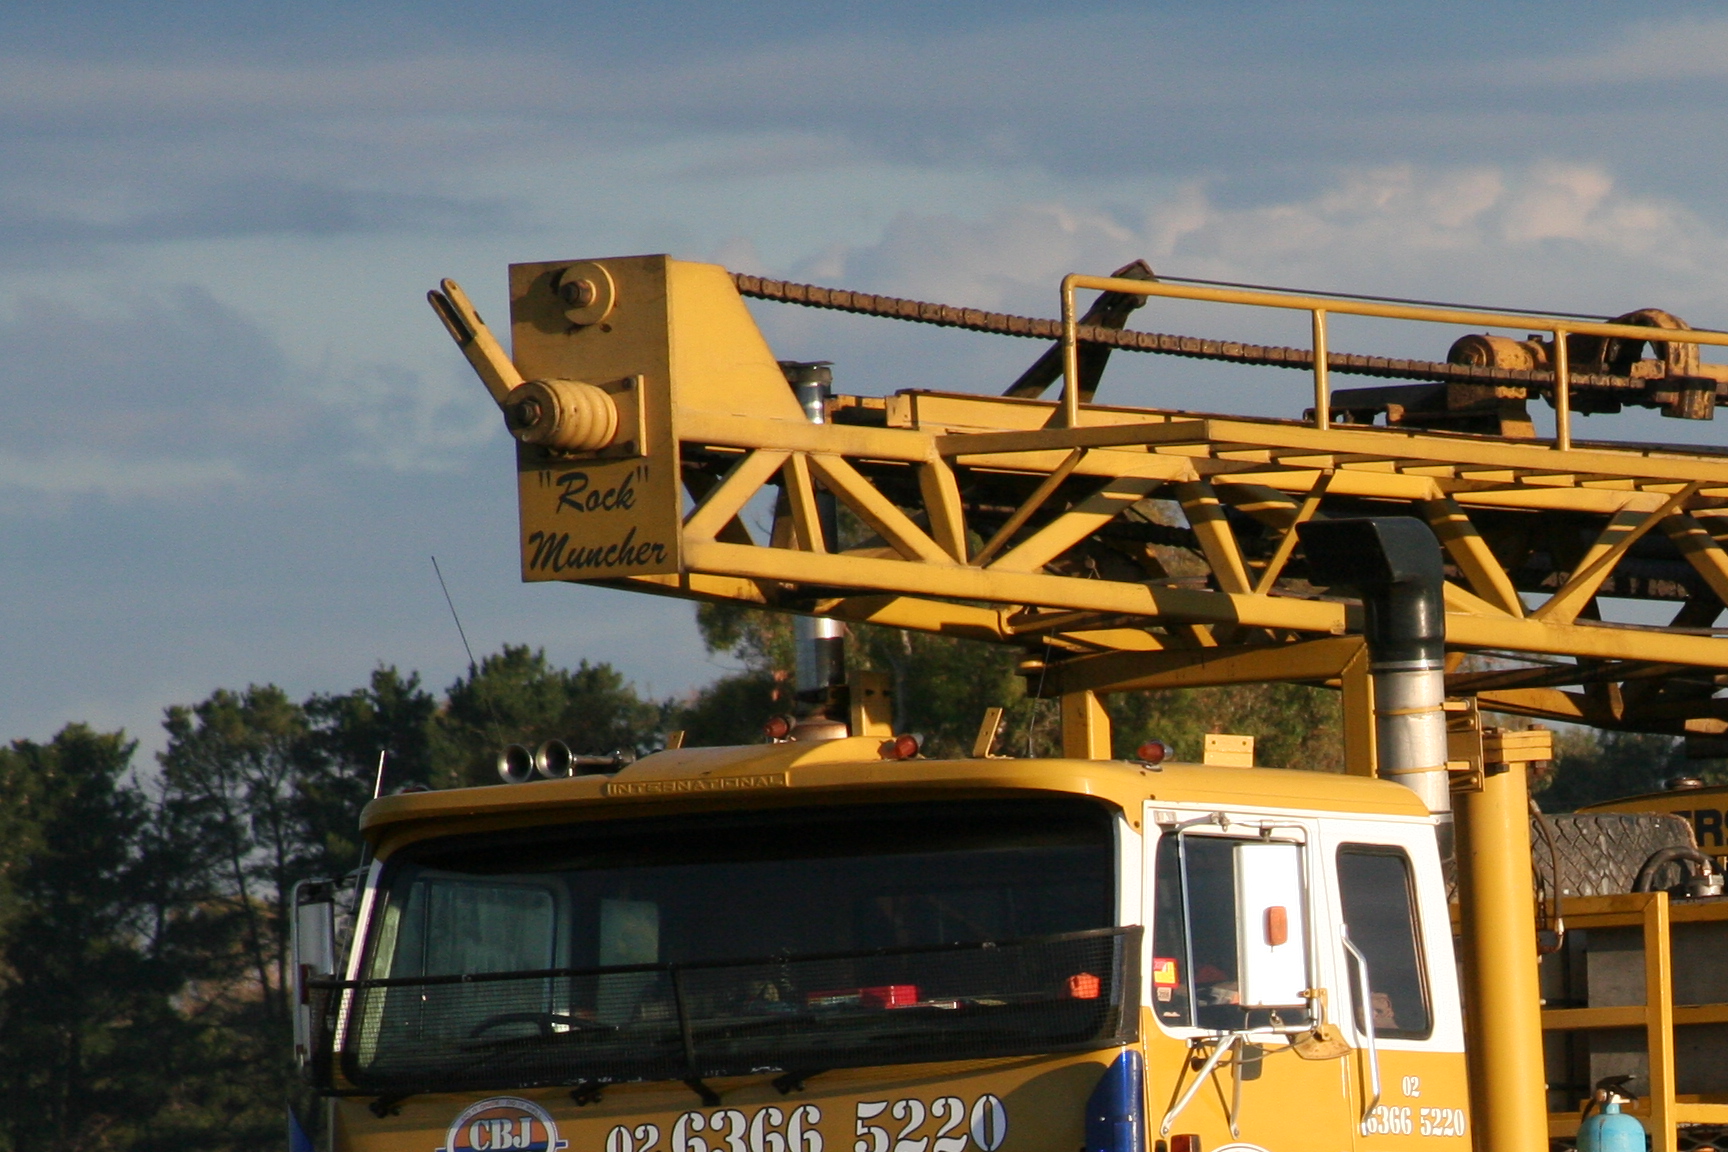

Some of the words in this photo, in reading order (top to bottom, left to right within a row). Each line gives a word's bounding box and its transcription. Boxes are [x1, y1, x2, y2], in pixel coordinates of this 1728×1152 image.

[539, 465, 649, 513] "Rock"
[529, 526, 667, 573] Muncher
[1402, 1076, 1420, 1097] 02
[469, 1116, 532, 1151] CBJ
[1367, 1106, 1412, 1135] 6366
[1420, 1107, 1465, 1136] 5220
